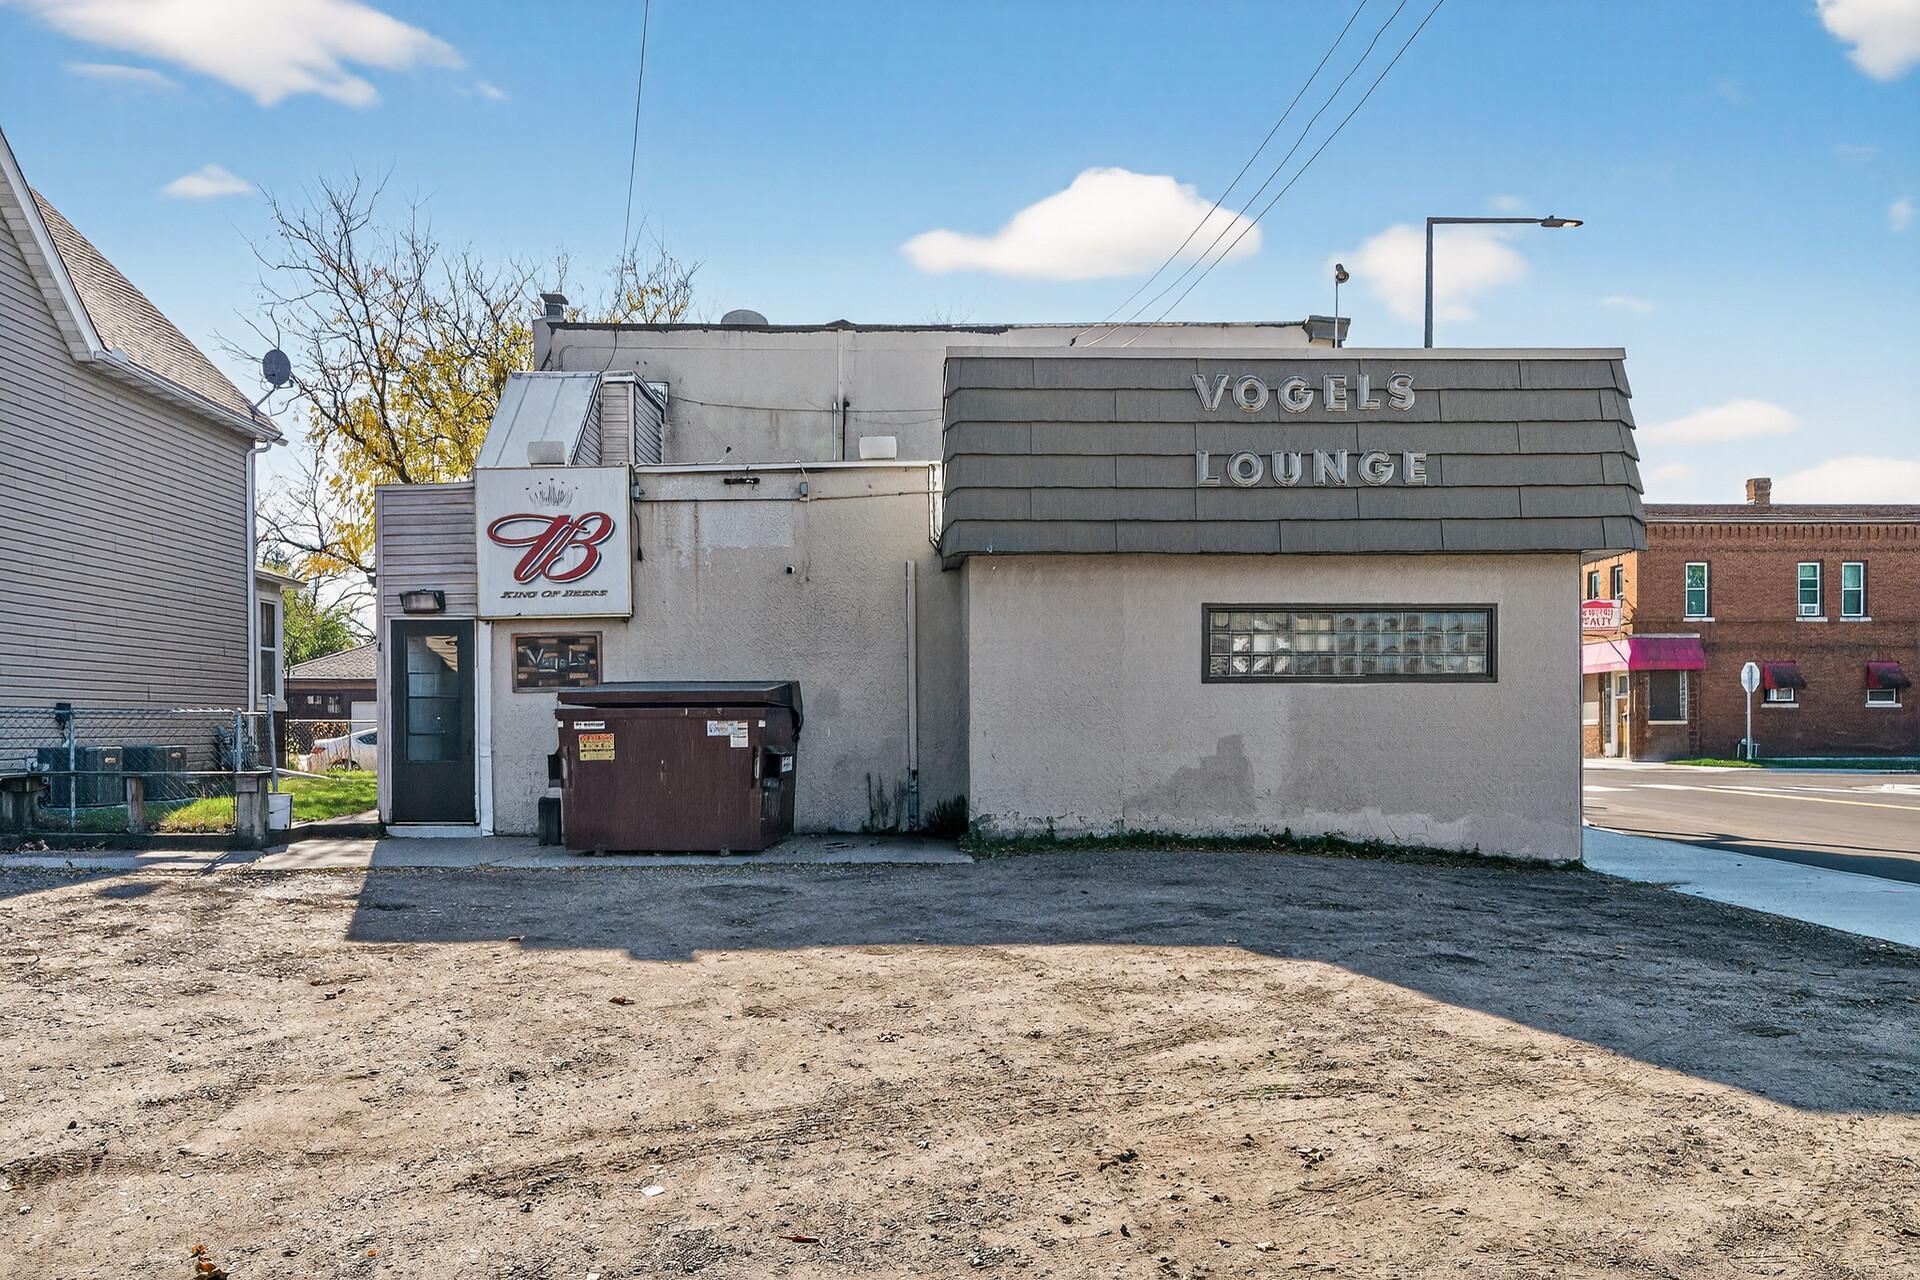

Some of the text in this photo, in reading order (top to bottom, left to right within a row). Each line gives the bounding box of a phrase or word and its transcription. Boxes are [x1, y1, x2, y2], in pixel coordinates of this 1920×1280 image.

[1192, 373, 1416, 413] VOGELS
[1196, 449, 1428, 487] LOUNGE
[500, 589, 609, 599] KING OF BEERS
